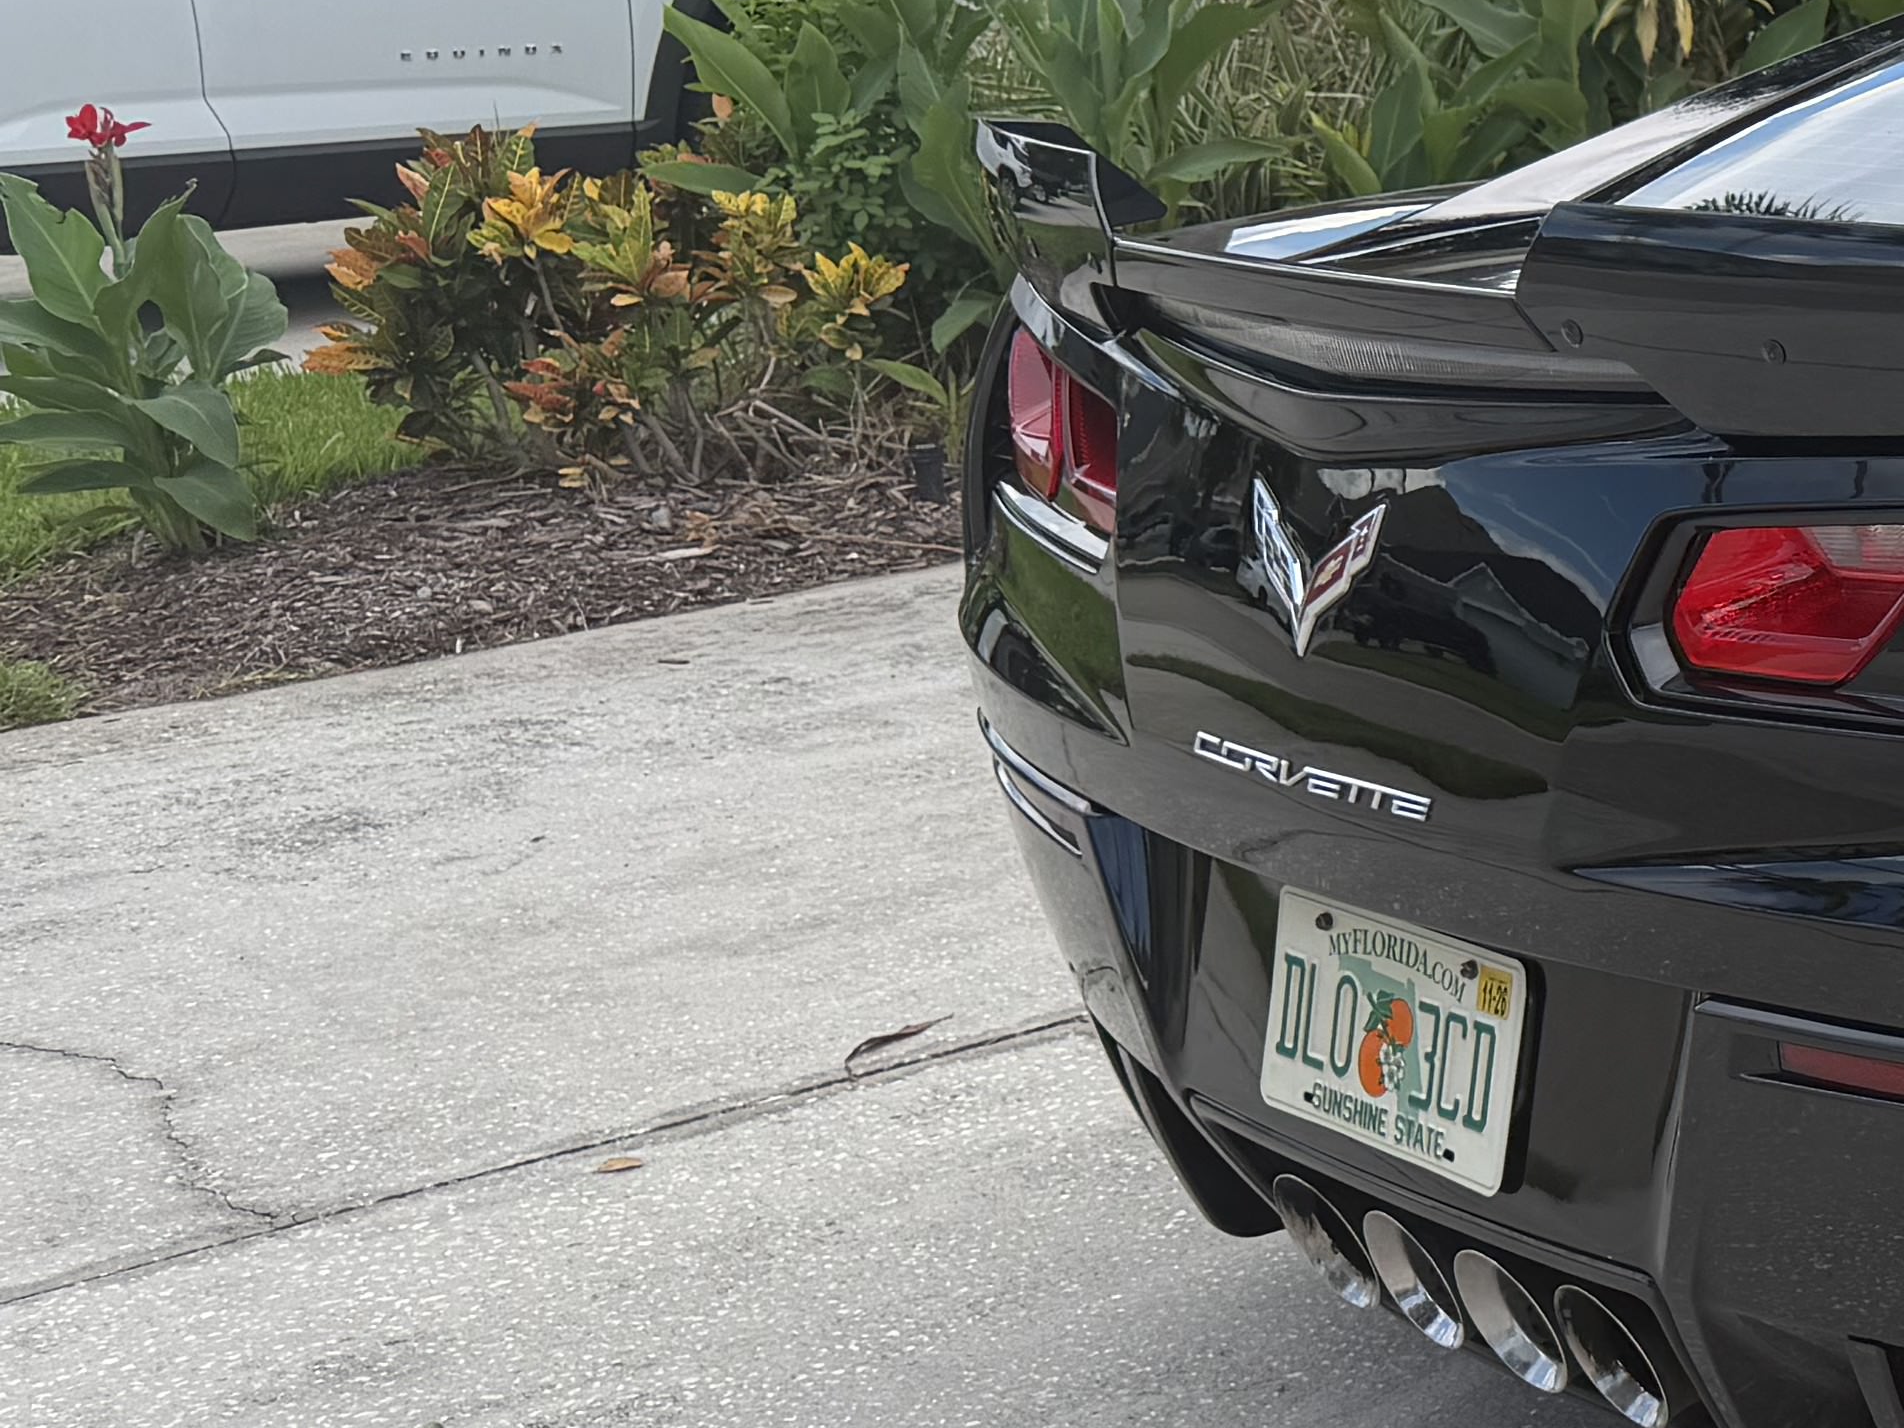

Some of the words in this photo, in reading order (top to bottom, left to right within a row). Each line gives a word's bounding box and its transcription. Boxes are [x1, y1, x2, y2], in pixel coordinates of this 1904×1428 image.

[1193, 730, 1432, 822] CORVETTE
[1328, 928, 1466, 1004] MYFLORIDA.COM
[1408, 998, 1497, 1133] 3CD
[1311, 1081, 1389, 1137] SUNSHINE
[1394, 1114, 1445, 1160] STATE
